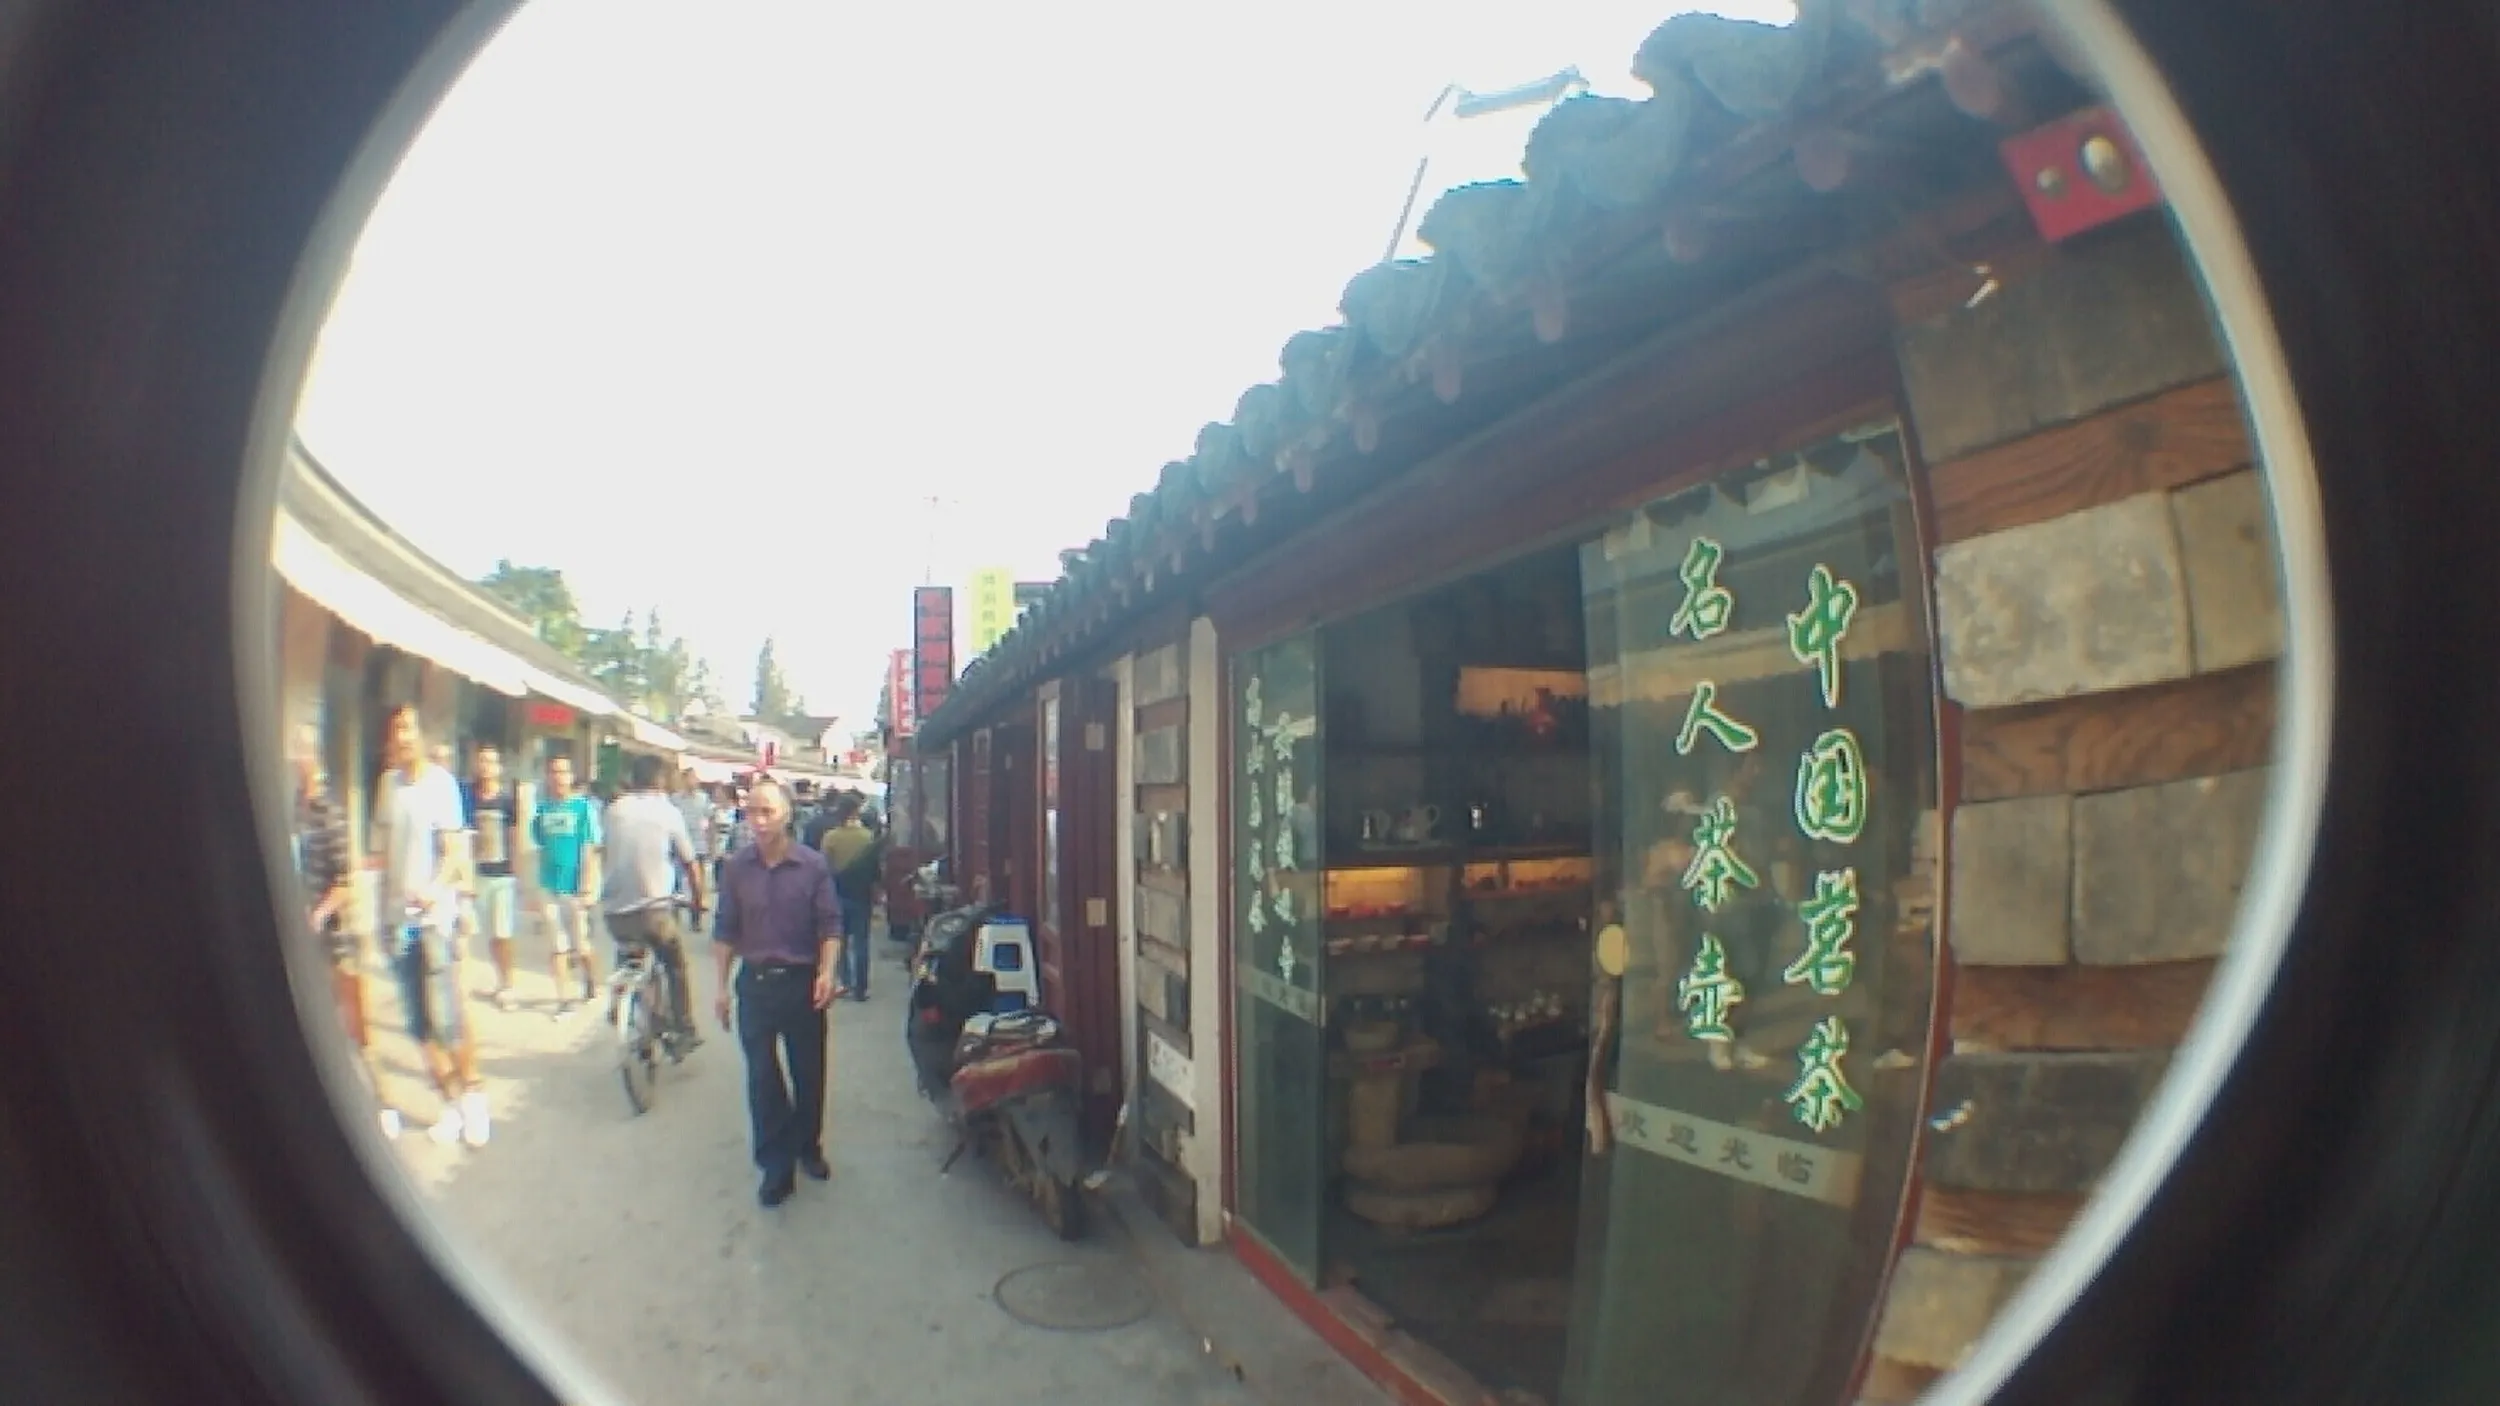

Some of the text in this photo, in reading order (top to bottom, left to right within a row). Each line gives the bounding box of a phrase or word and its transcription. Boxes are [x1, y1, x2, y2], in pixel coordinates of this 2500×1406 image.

[1669, 536, 1759, 1040] 名人茶壶
[1784, 563, 1866, 1132] 中国茗茶
[1619, 1110, 1815, 1184] 欢迎光临
